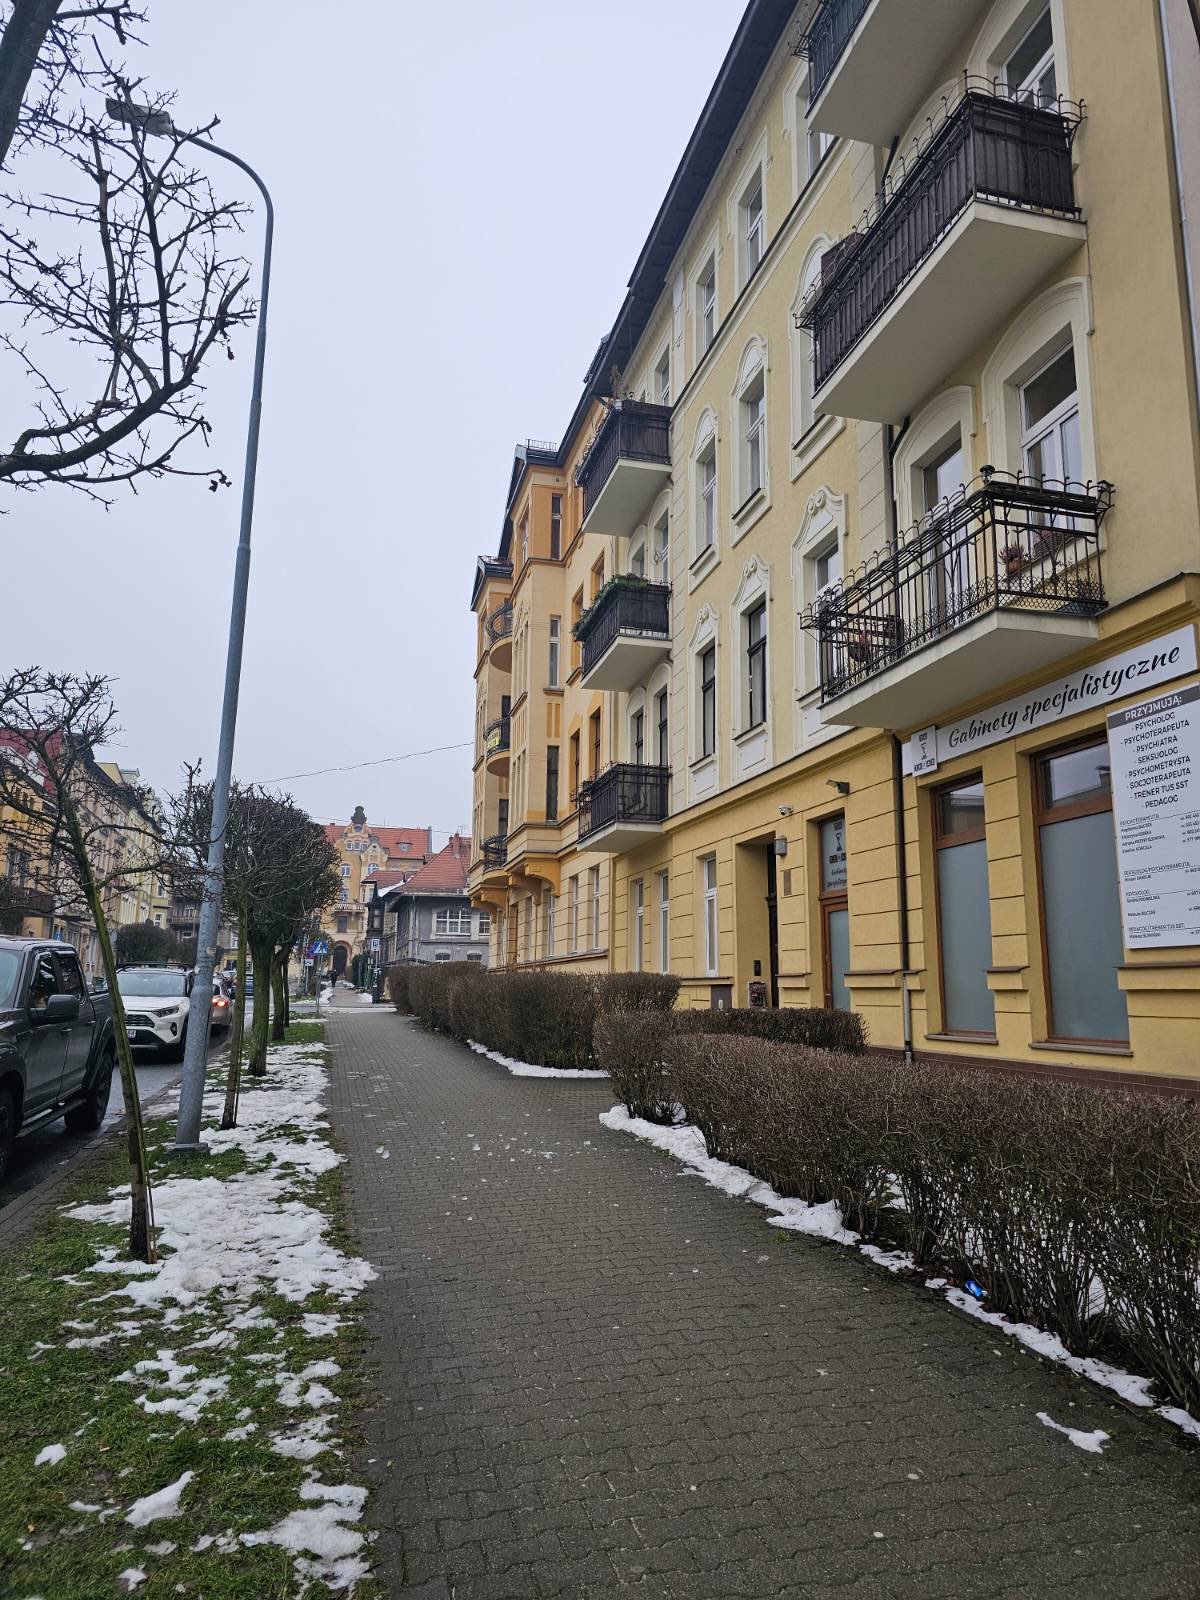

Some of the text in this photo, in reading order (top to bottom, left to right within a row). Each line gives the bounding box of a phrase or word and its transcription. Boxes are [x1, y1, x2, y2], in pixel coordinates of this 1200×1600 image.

[949, 646, 1180, 748] Gabinety specjalistyczne
[1125, 696, 1182, 720] PRZYJMUJĄ:
[1135, 712, 1175, 731] PSYCHOLOG
[1124, 720, 1190, 746] PSYCHOTERAPEUTA
[1136, 735, 1178, 753] PSYCHIATRA
[1138, 746, 1178, 764] SEKSUOLOG
[1128, 756, 1191, 778] PSYCHOMETRYSTA
[1129, 767, 1191, 789] SOCJOTERAPEUTA
[1134, 780, 1189, 800] TRENER TUS SST
[1145, 795, 1178, 808] PEDAGOG
